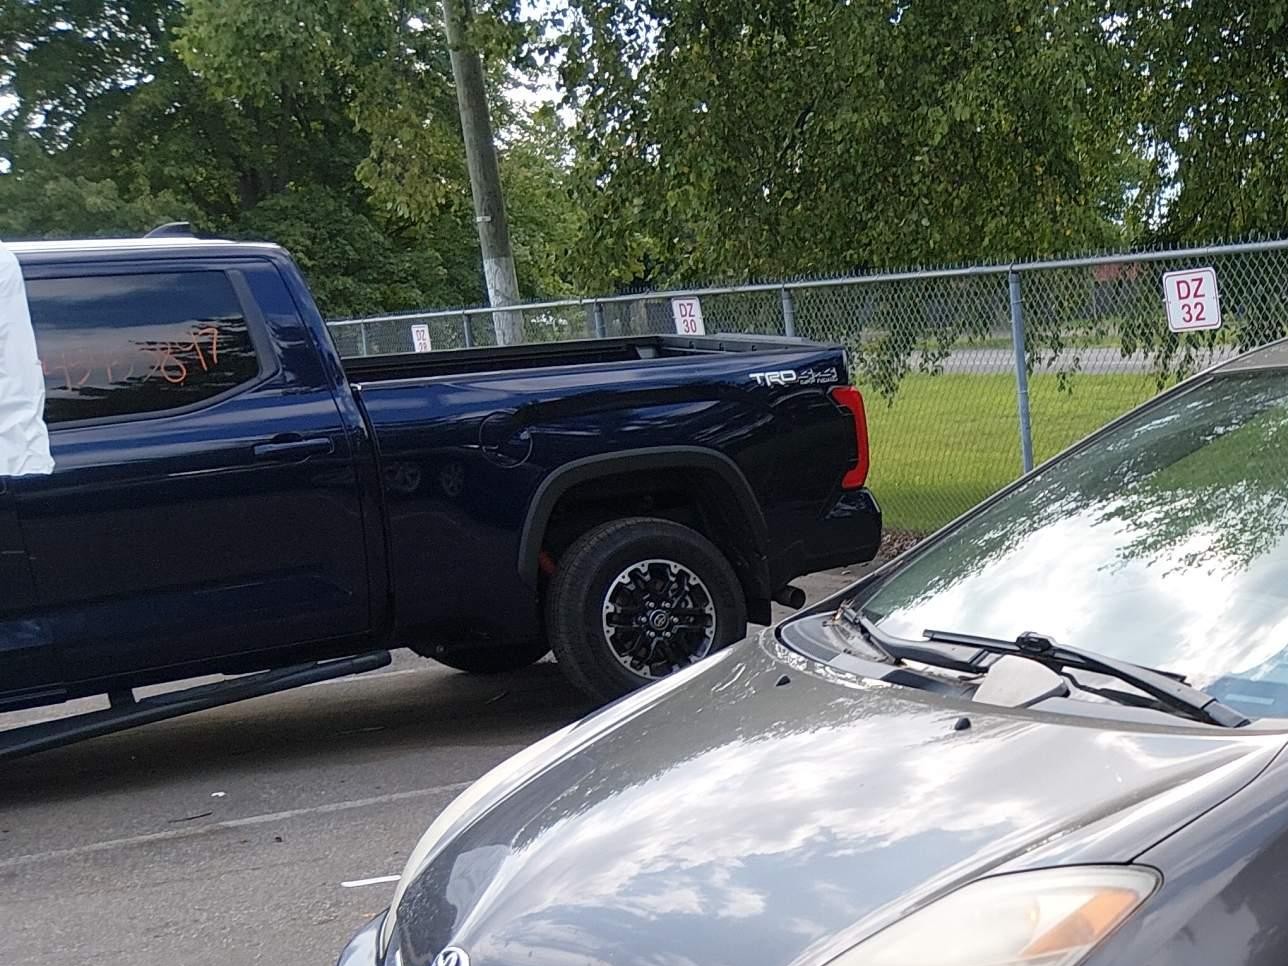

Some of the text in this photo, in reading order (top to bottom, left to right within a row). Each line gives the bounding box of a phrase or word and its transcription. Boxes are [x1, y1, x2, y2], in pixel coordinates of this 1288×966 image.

[1176, 277, 1206, 300] DZ
[679, 303, 695, 318] DZ
[1181, 302, 1206, 323] 32
[683, 319, 697, 333] 30
[749, 369, 797, 387] TRD
